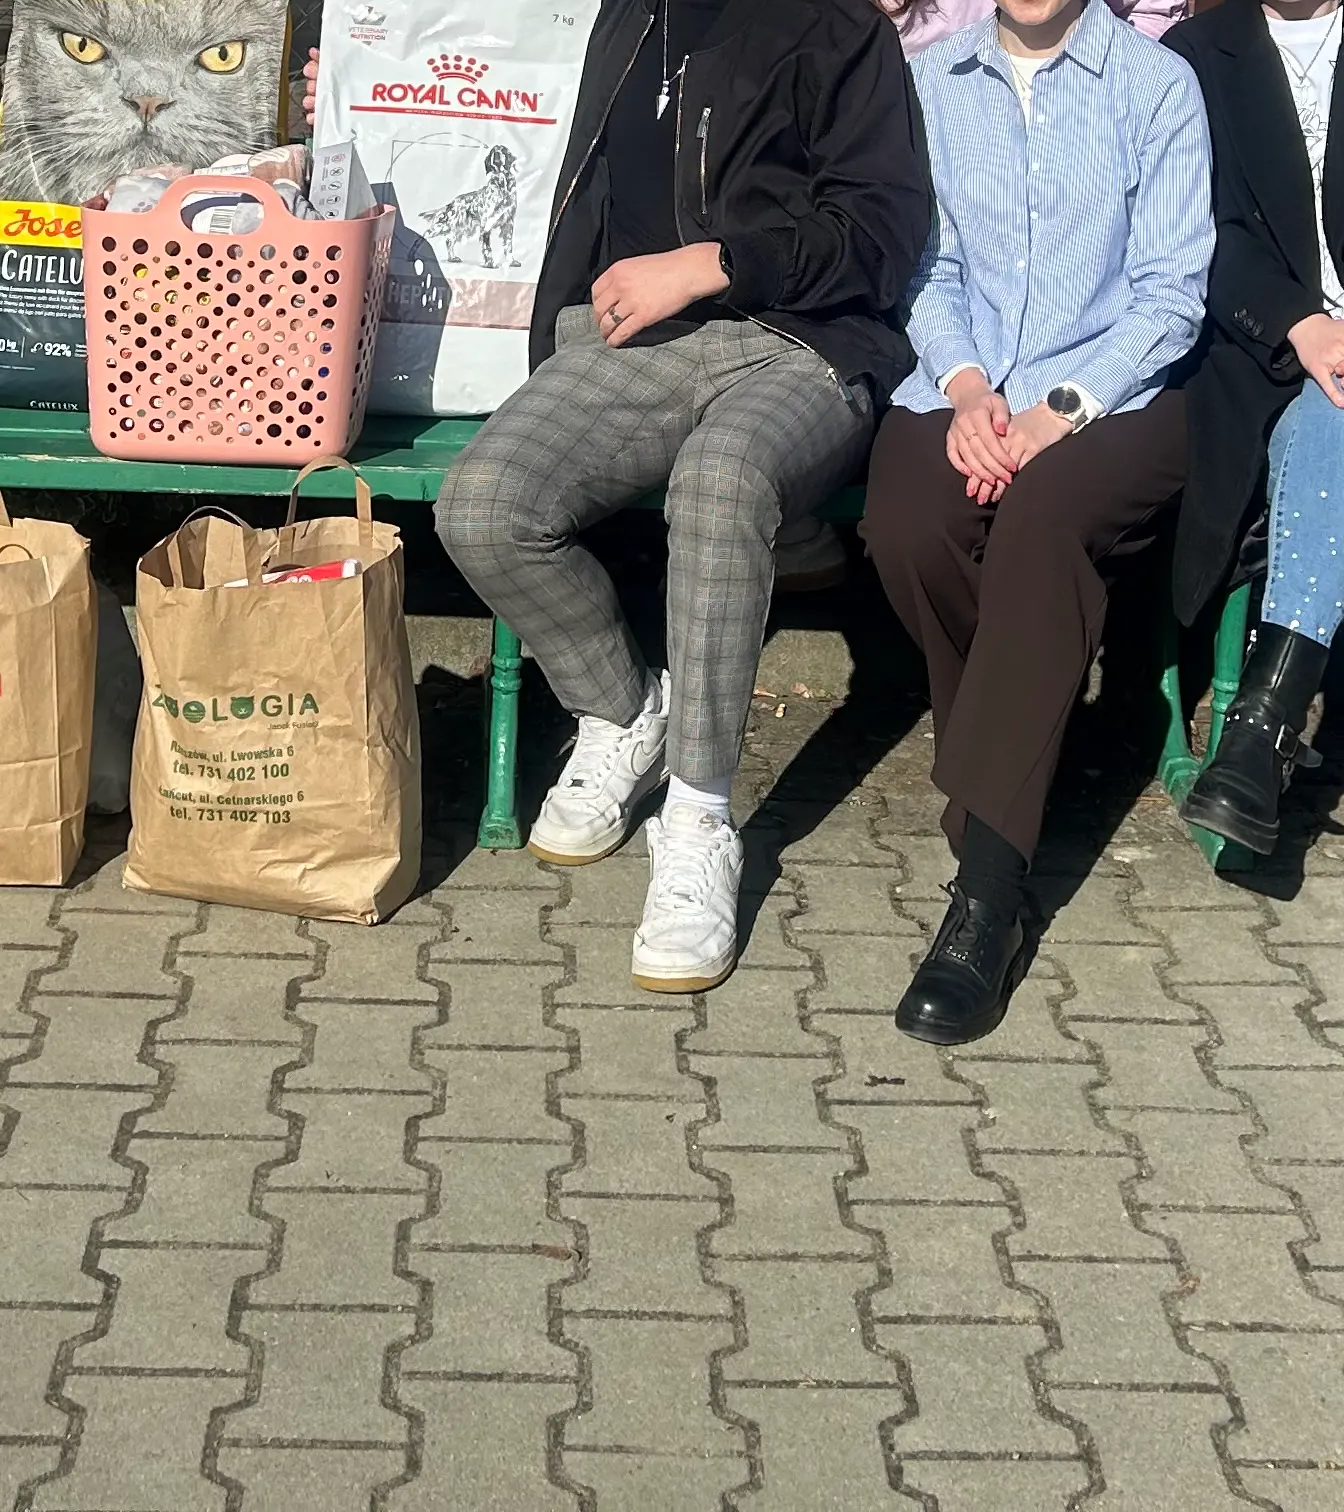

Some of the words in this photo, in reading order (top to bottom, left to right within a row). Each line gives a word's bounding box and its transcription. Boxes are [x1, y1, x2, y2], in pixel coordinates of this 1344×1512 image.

[552, 14, 560, 23] 7
[562, 14, 574, 26] kg
[372, 83, 451, 106] ROYAL
[4, 209, 82, 238] Jose
[1, 249, 84, 284] CATELU
[6, 339, 17, 349] kg
[44, 342, 72, 357] 92%
[212, 751, 227, 763] ul.
[231, 747, 283, 762] Lwowska
[287, 745, 294, 757] 6
[173, 759, 194, 776] tel.
[197, 764, 222, 780] 731
[227, 766, 256, 781] 402
[262, 763, 289, 779] 100
[199, 793, 213, 804] ul.
[217, 793, 293, 806] Cetnarskiego
[297, 790, 305, 802] 6
[170, 805, 192, 821] tel.
[196, 808, 223, 821] 731
[229, 810, 258, 823] 402
[264, 810, 291, 825] 103
